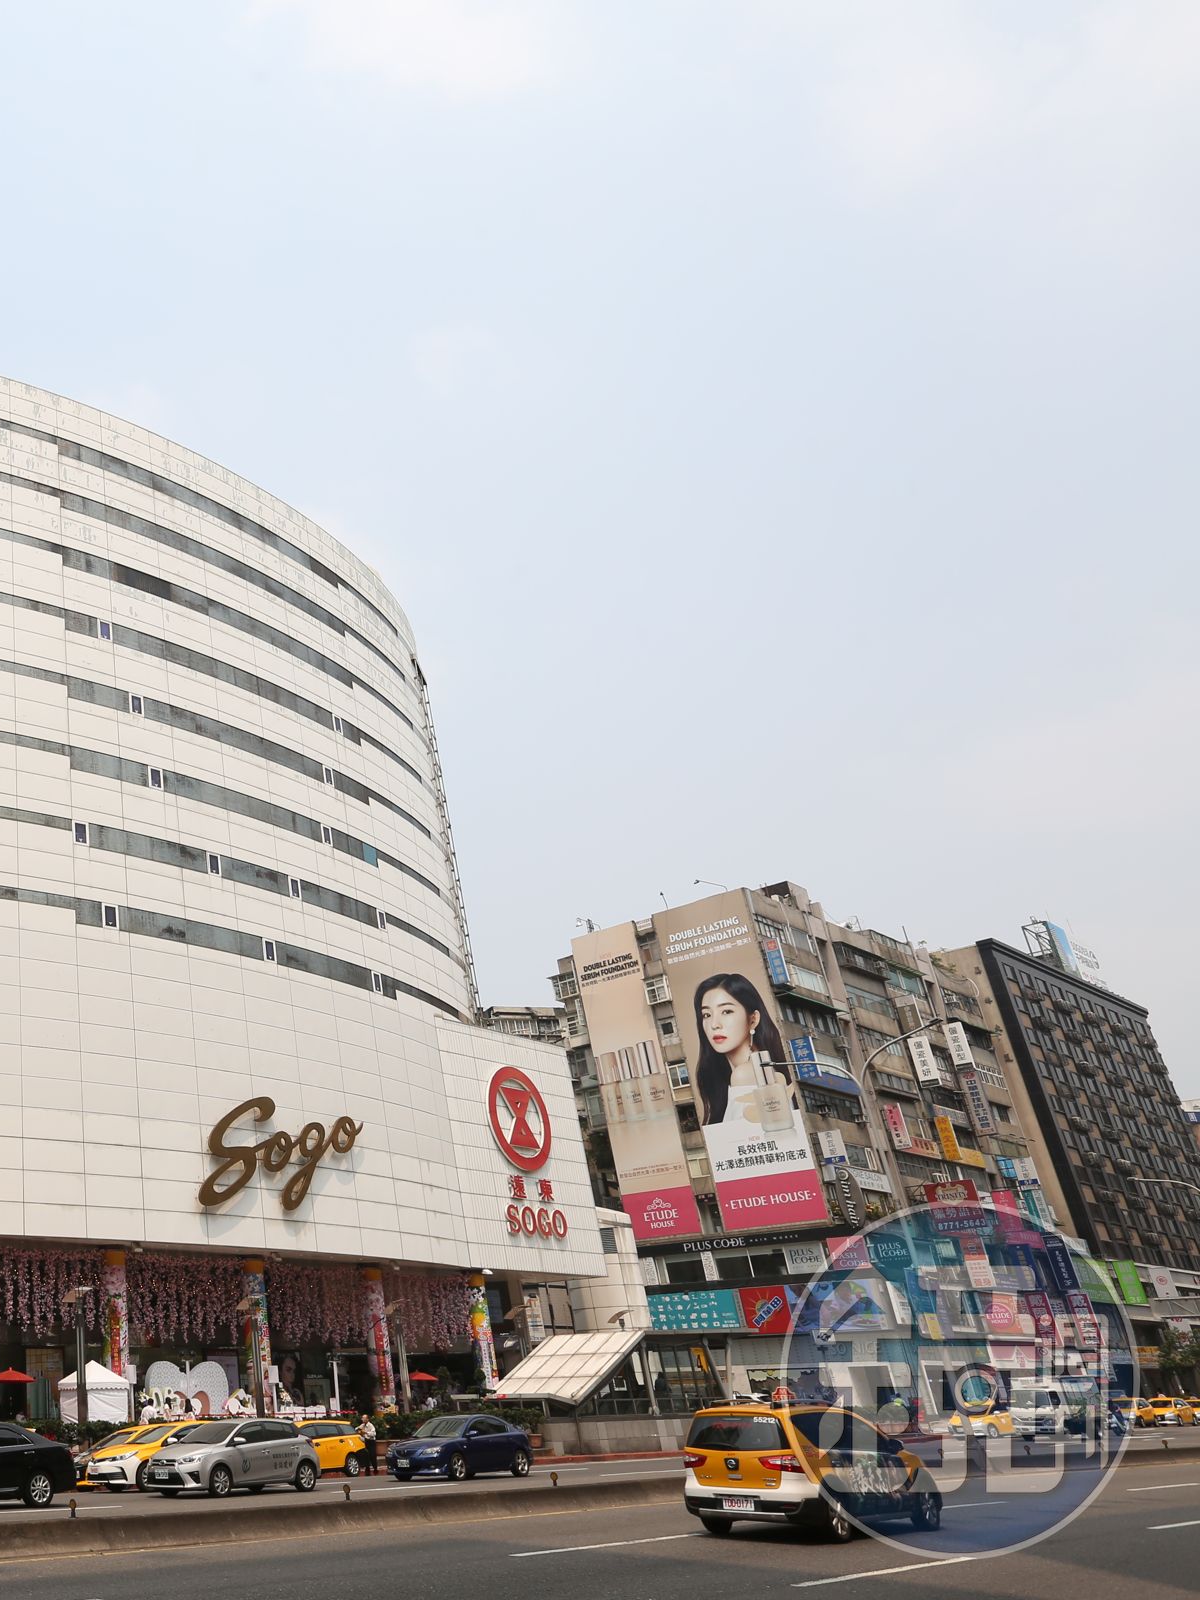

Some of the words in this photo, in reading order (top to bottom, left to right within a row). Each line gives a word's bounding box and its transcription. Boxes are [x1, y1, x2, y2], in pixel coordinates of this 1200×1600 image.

[669, 927, 703, 943] DOUBLE
[704, 916, 740, 934] LASTING
[665, 941, 694, 955] SERUM
[694, 925, 749, 949] FOUNDATION
[583, 959, 607, 972] DOUBLE
[608, 953, 633, 966] LASTING
[580, 971, 600, 982] SERUM
[601, 961, 639, 977] FOUNDATION
[198, 1096, 364, 1211] Sogo
[508, 1173, 554, 1202] 遠東
[730, 1195, 768, 1210] ETUDE
[770, 1190, 813, 1205] HOUSE
[505, 1203, 568, 1240] SOGO
[643, 1208, 679, 1223] ETUDE
[650, 1220, 675, 1230] HOUSE
[683, 1240, 712, 1253] PLUS
[713, 1236, 746, 1250] CODE
[877, 1241, 902, 1257] PLUS
[883, 1248, 909, 1258] CODE
[789, 1247, 814, 1264] PLUS
[794, 1255, 822, 1264] CODE
[839, 1259, 869, 1267] CODE
[986, 1312, 1012, 1320] ETUDE
[753, 1416, 775, 1424] 55212
